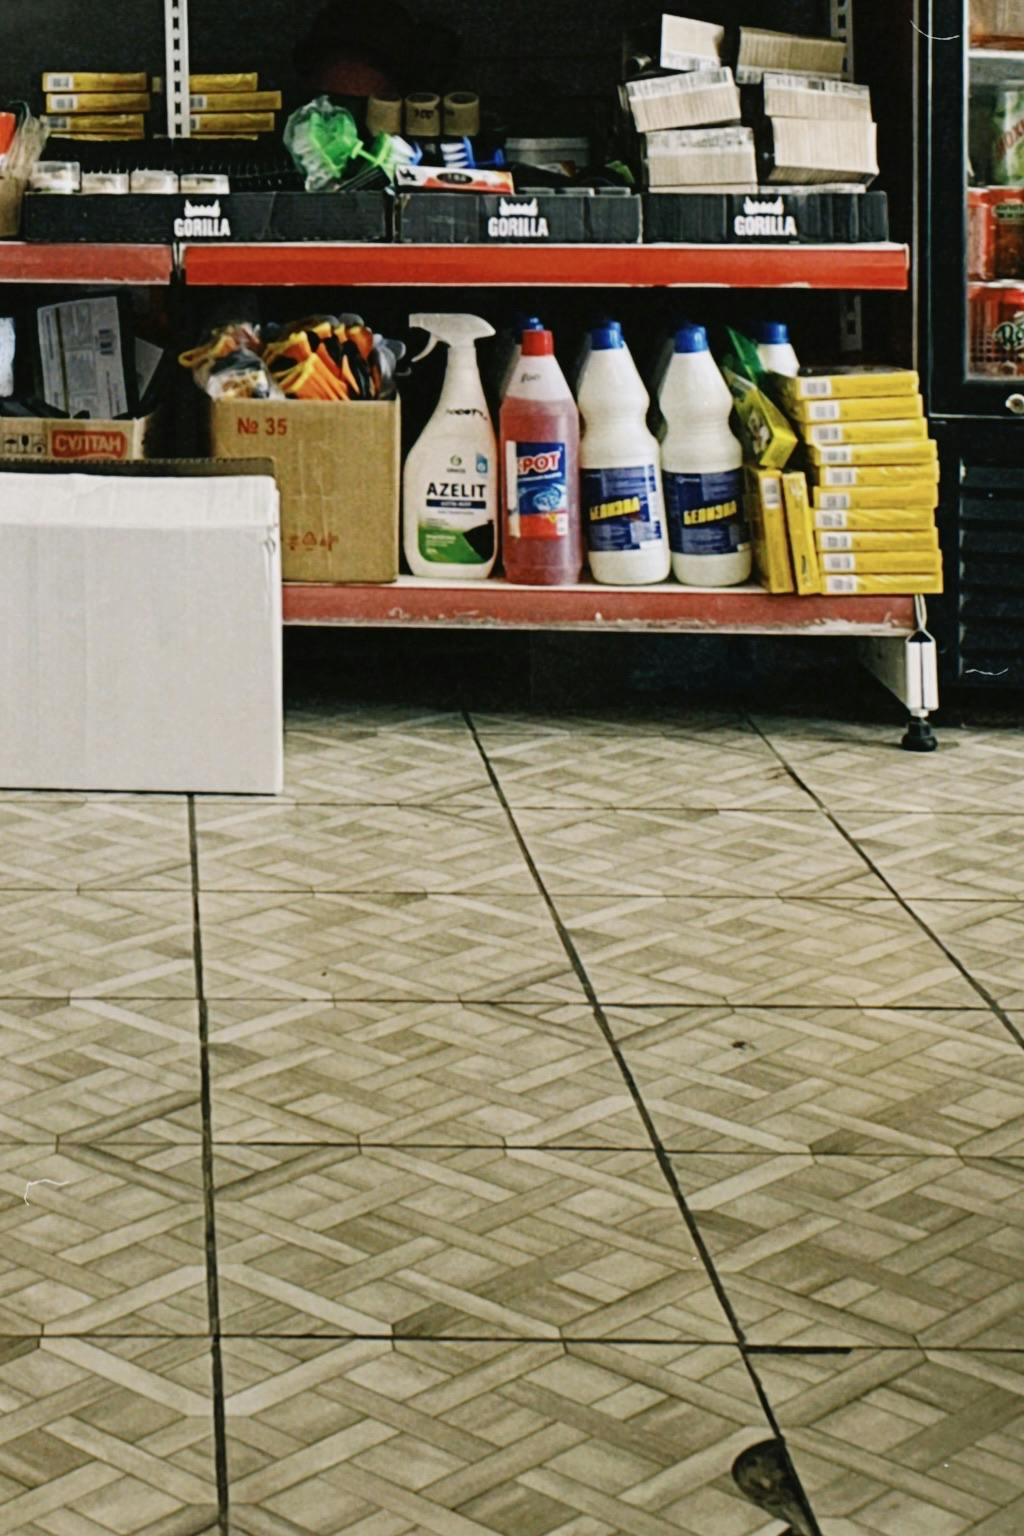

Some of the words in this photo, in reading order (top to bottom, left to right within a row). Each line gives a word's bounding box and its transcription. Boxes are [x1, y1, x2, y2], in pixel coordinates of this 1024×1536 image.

[174, 219, 231, 237] GORILLA
[488, 216, 550, 237] GORILLA
[734, 215, 797, 237] GORILLA
[265, 417, 288, 436] 35
[426, 482, 487, 499] AZELIT
